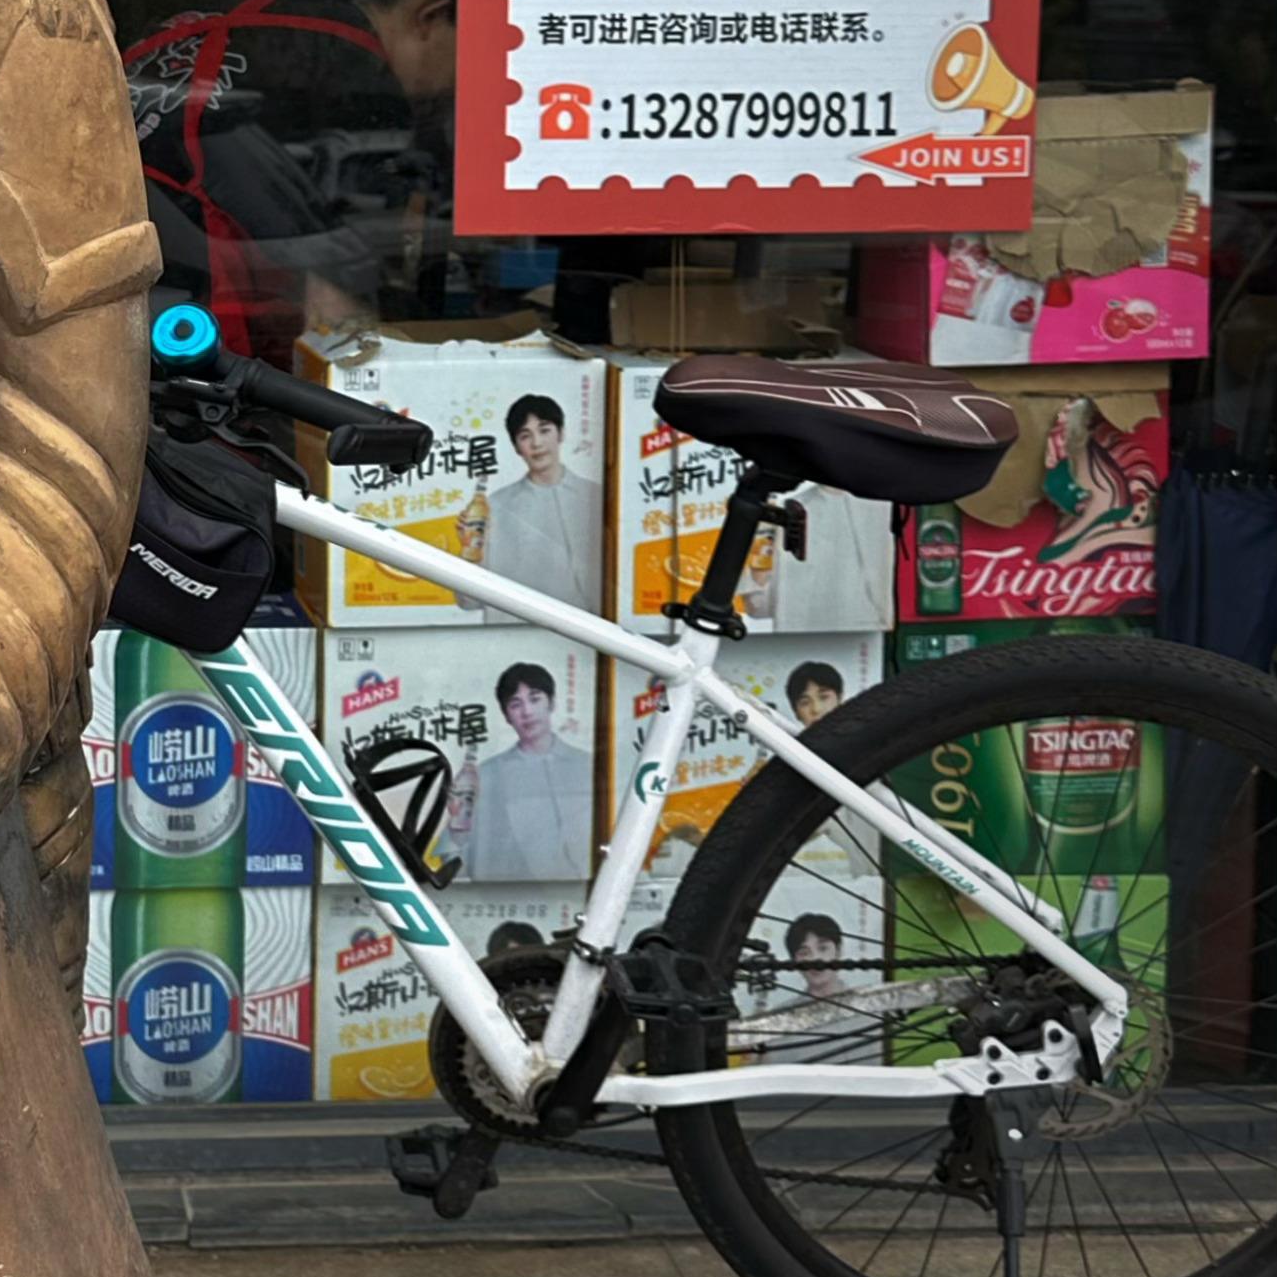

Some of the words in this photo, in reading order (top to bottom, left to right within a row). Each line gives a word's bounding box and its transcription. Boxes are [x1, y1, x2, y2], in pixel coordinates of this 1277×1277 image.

[537, 11, 886, 46] 者可进店咨询或电话联系。
[893, 146, 963, 169] JOIN
[971, 145, 1022, 168] US!
[130, 542, 220, 601] MERIDA
[347, 682, 397, 711] HANS
[147, 725, 217, 764] 崂山
[147, 759, 216, 784] LAOSHAN
[930, 733, 982, 839] 190
[900, 838, 981, 895] MOUNTAIN
[341, 941, 390, 967] HANS
[143, 981, 213, 1021] 崂山
[243, 989, 299, 1041] SHAN
